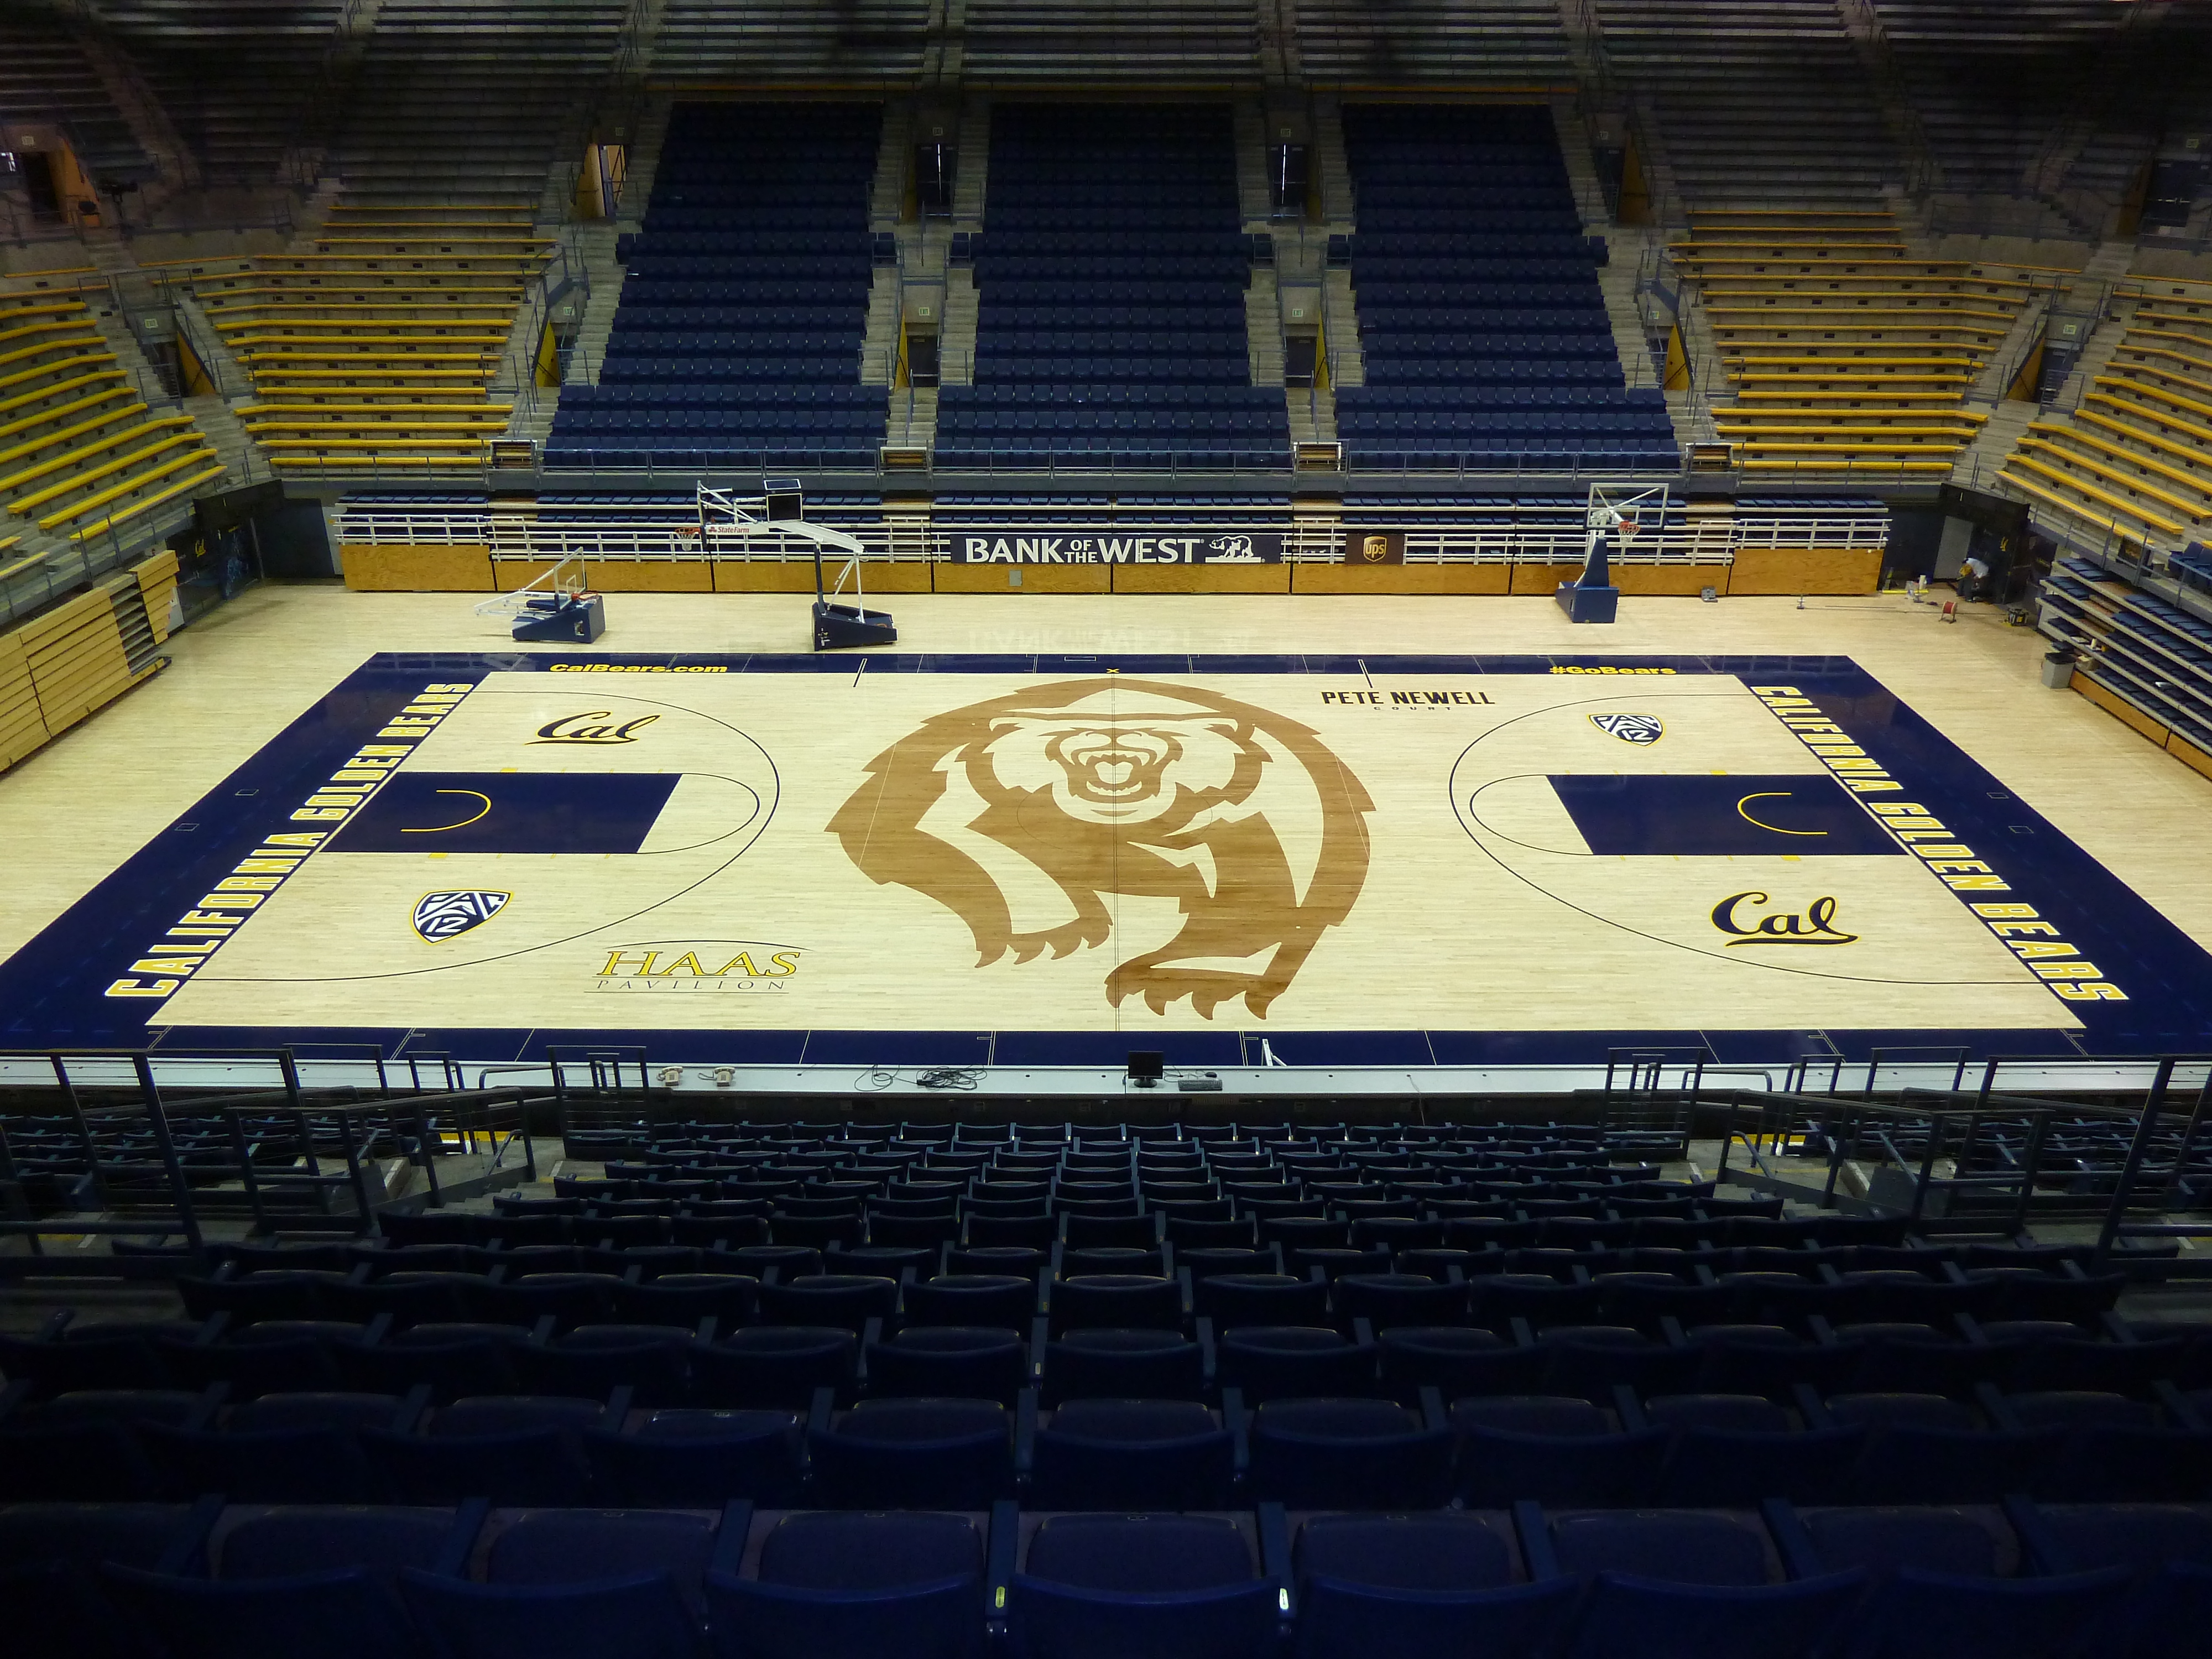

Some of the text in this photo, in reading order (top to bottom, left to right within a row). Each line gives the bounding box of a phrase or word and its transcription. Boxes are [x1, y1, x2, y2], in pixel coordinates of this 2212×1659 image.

[965, 538, 1202, 563] BANK OF THE WEST
[1365, 544, 1385, 558] ups
[550, 664, 728, 673] CalBears.com
[1549, 666, 1677, 675] #GoBears
[1321, 691, 1495, 705] PETE NEWELL
[524, 711, 661, 745] Cal
[1621, 730, 1653, 740] 12
[105, 683, 474, 997] CALIFORNIA GOLDEN BEARS
[1750, 686, 2129, 1000] CALIFORNIA GOLDEN BEARS
[418, 892, 505, 921] PAC
[426, 917, 468, 933] 12
[1710, 890, 1860, 947] Cal
[597, 951, 801, 977] HAAS
[597, 980, 785, 990] PAVILION
